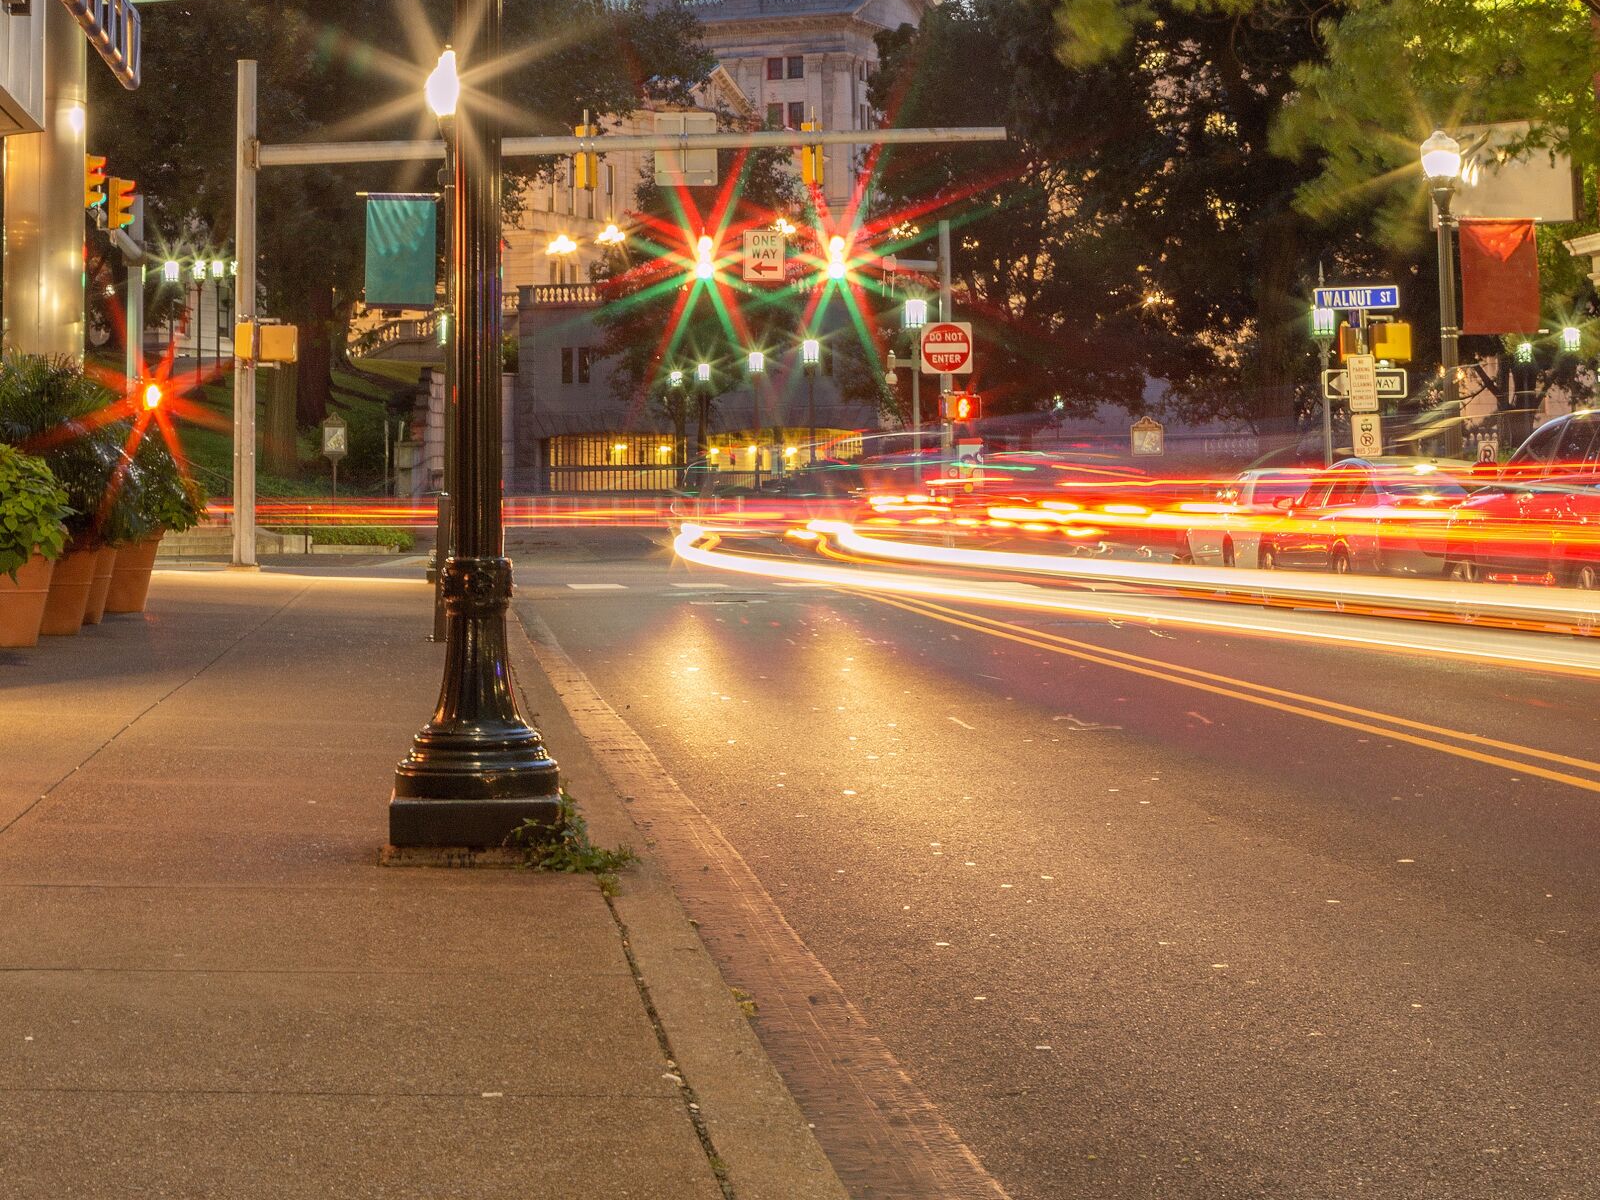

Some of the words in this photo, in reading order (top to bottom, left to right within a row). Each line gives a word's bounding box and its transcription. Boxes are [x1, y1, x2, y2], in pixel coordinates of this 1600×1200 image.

[753, 235, 777, 247] ONE
[752, 249, 778, 259] WAY
[1322, 289, 1372, 307] WALNUT
[1380, 291, 1392, 303] ST
[929, 332, 942, 342] DO
[944, 332, 963, 342] NOT
[932, 354, 962, 364] ENTER
